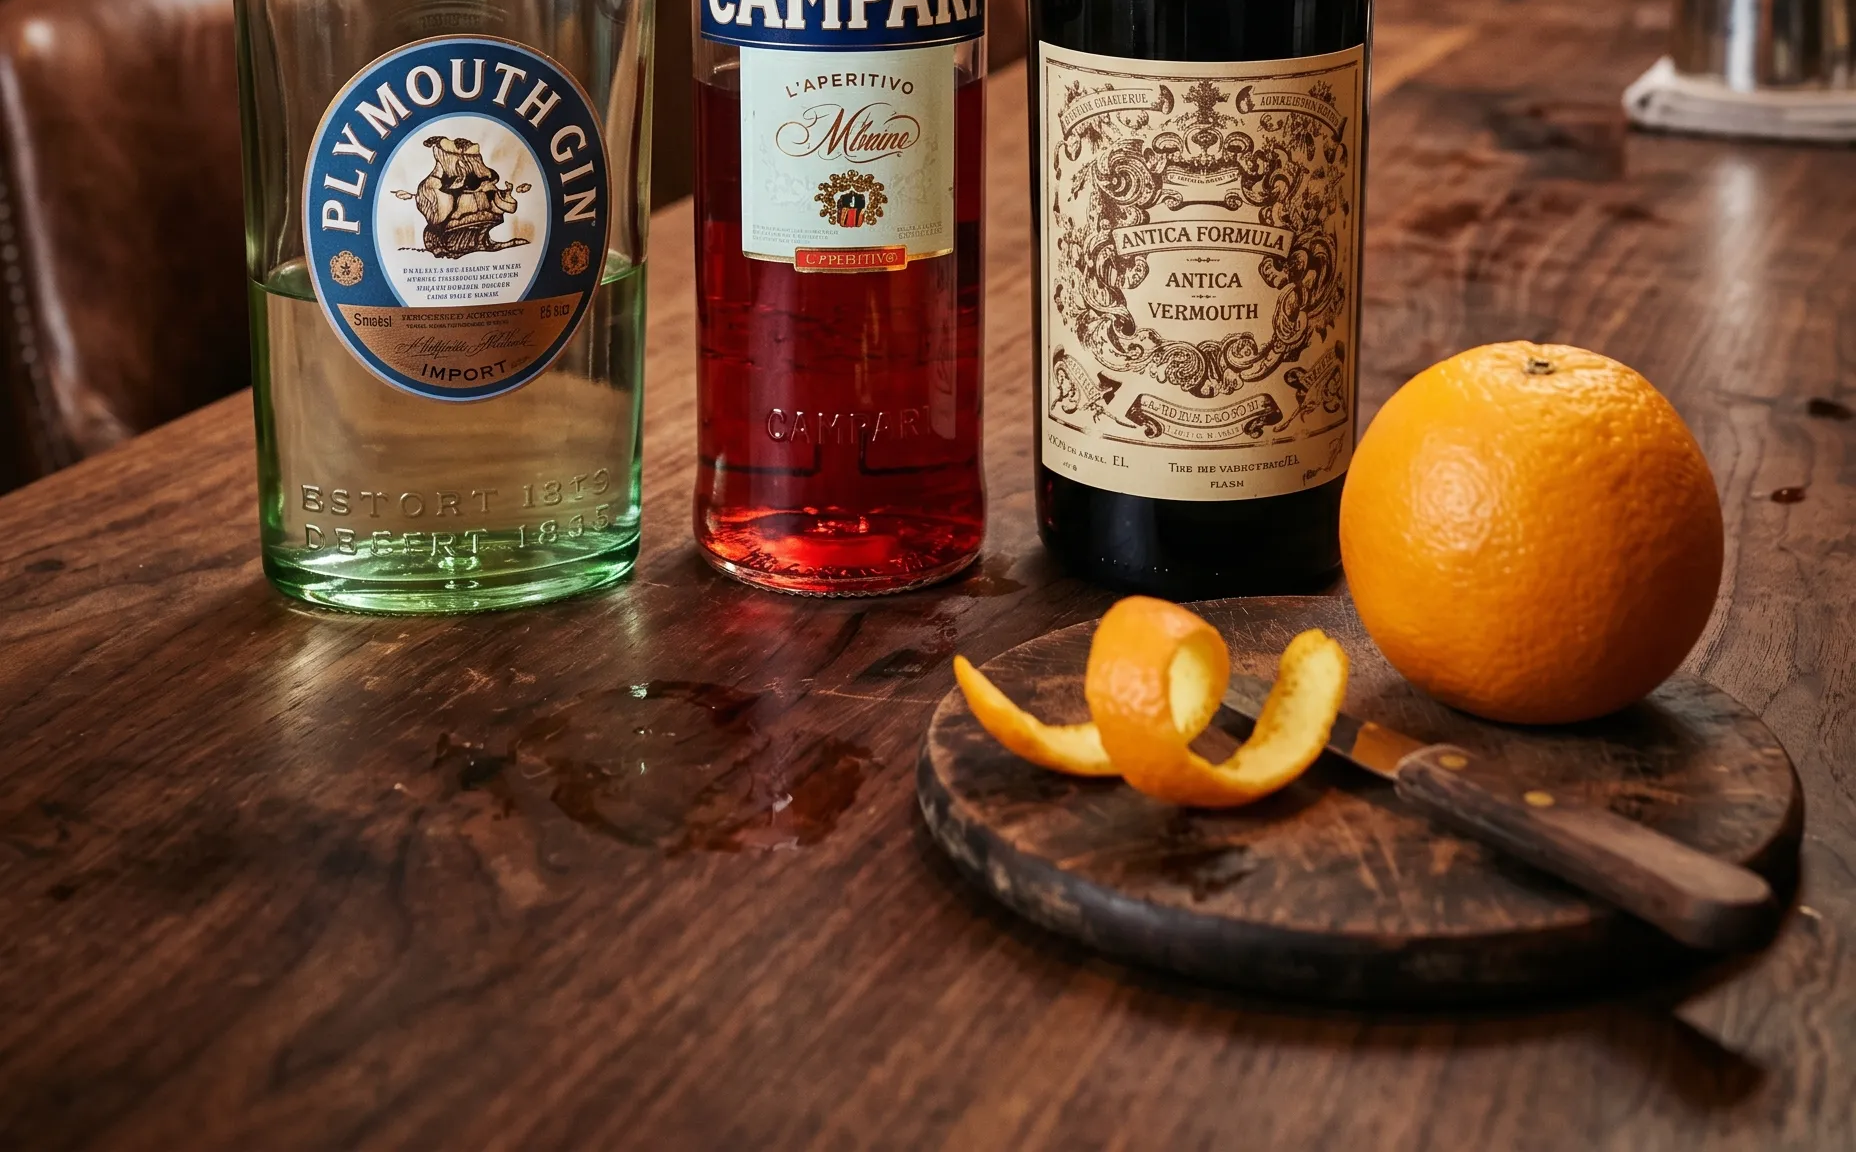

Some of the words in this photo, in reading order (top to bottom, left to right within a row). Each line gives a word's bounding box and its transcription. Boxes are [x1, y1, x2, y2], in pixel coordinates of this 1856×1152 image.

[785, 72, 915, 99] L'APERITIVO
[321, 57, 562, 236] PLYMOUTH
[549, 124, 596, 231] GIN
[1121, 226, 1192, 249] ANTICA
[1197, 225, 1286, 250] FORMULA
[1165, 272, 1243, 289] ANTICA
[1148, 302, 1259, 321] VERMOUTH
[421, 359, 507, 382] IMPORT
